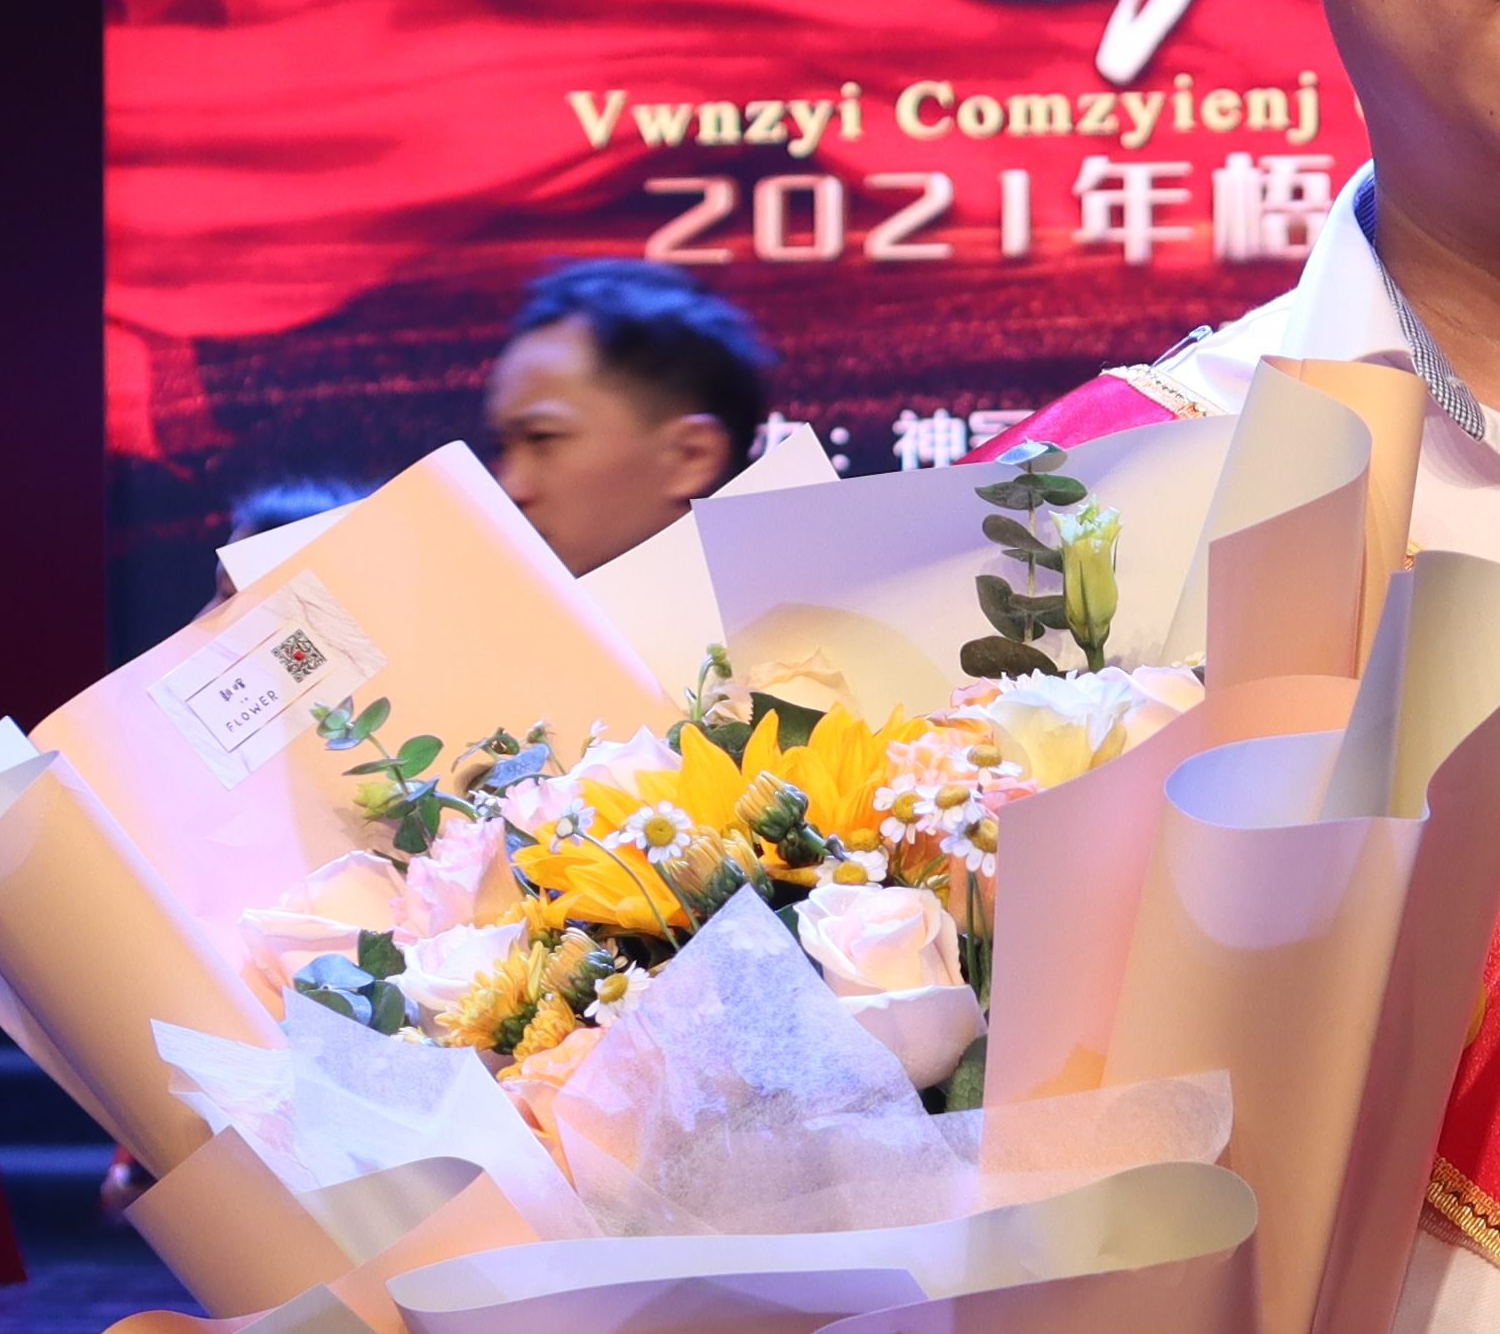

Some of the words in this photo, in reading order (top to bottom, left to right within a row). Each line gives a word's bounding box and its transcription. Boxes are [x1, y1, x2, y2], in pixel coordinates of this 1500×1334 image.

[567, 81, 864, 157] Vwnzyi
[896, 70, 1320, 147] Comzyienj
[225, 690, 279, 733] FLOWER
